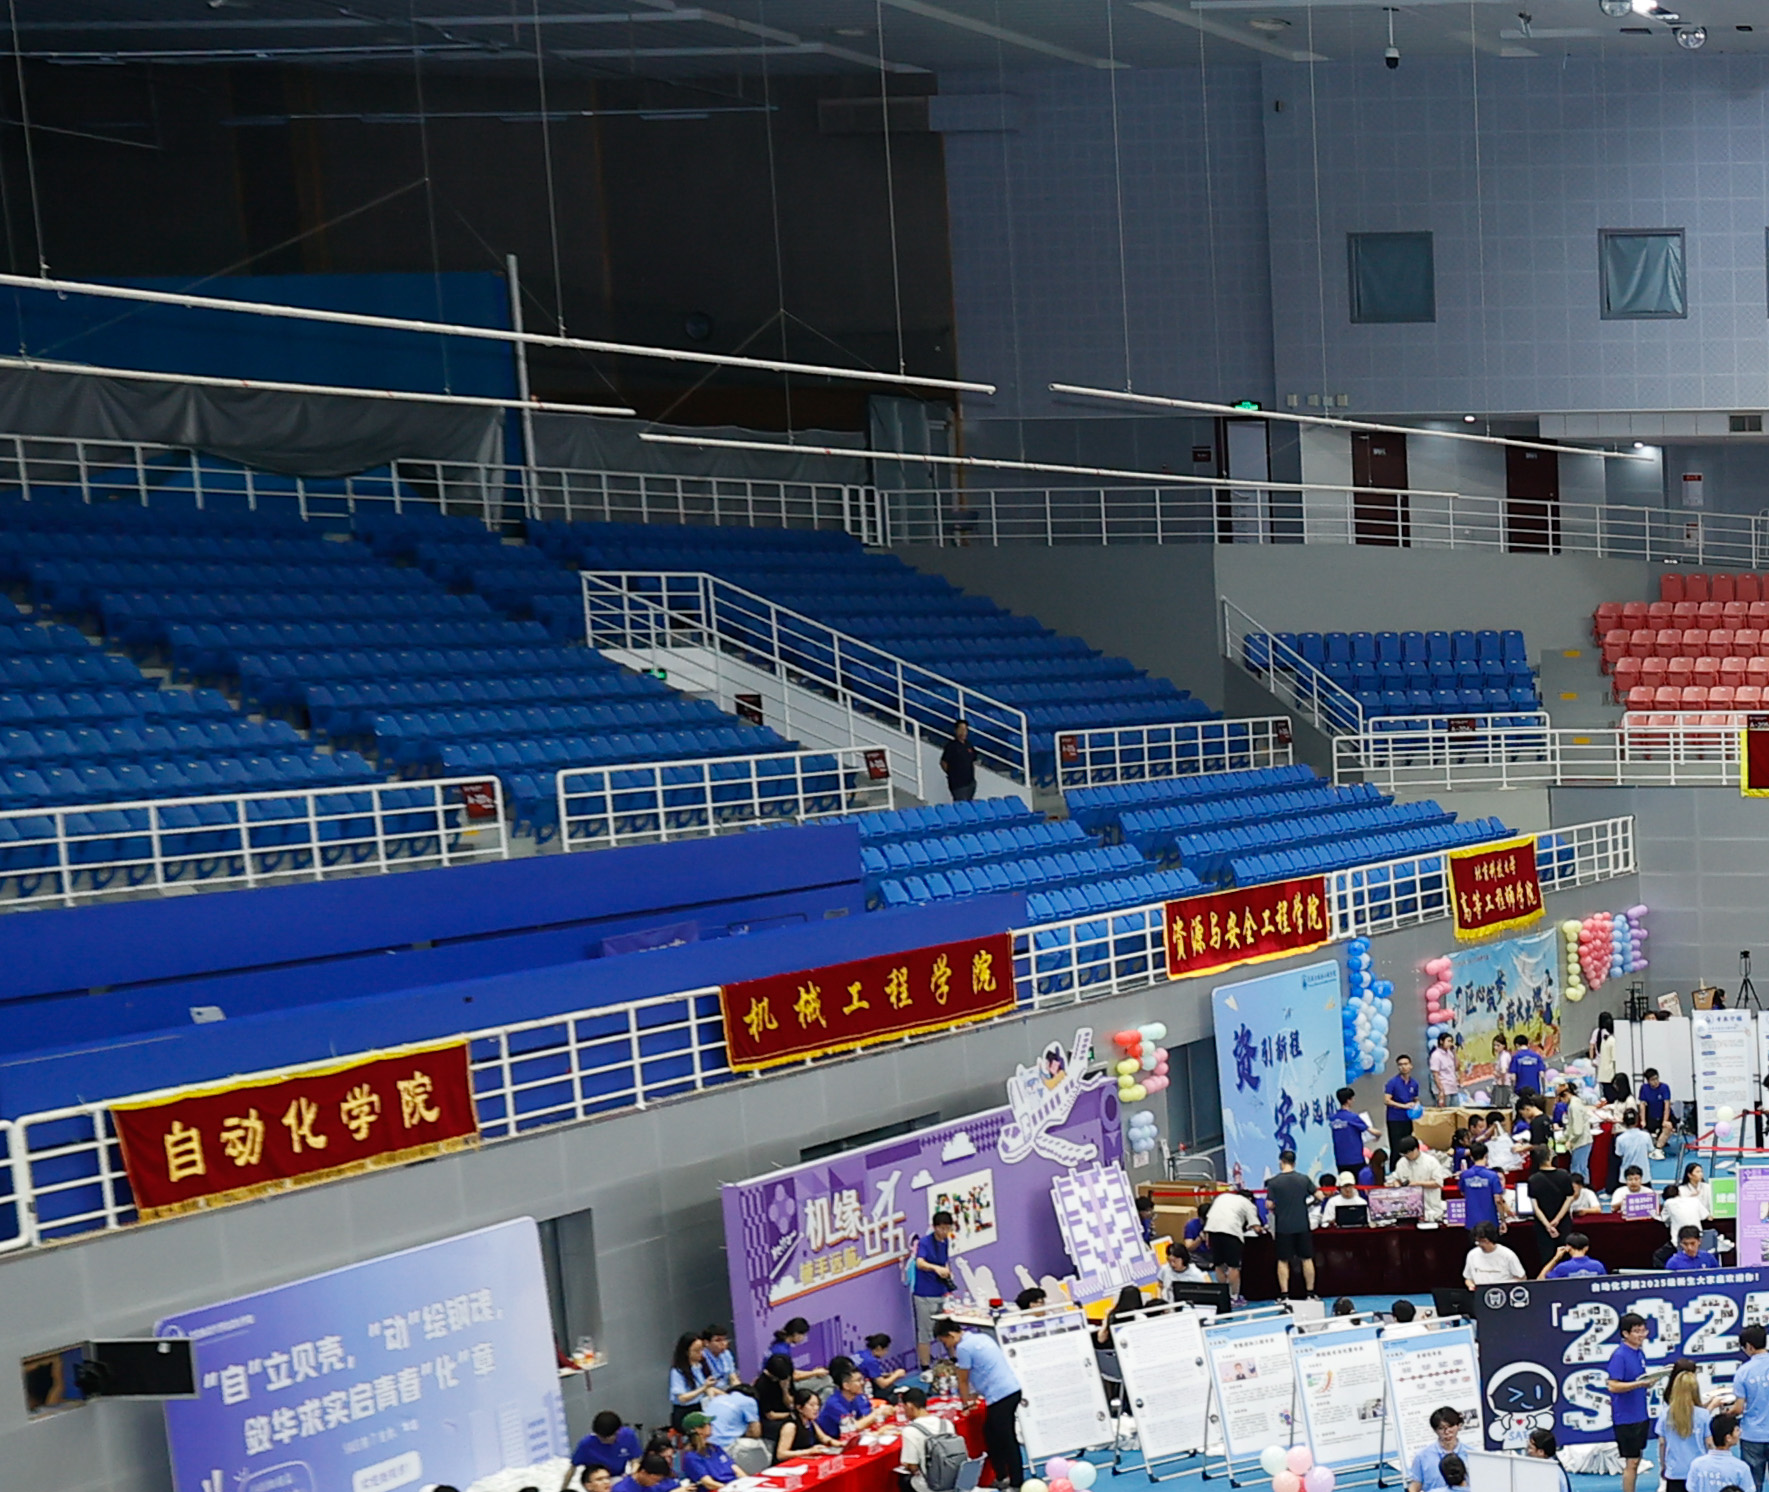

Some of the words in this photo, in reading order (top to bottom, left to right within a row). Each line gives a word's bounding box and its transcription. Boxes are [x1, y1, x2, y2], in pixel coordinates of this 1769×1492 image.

[1171, 890, 1324, 962] 资源与安全工程学院
[743, 948, 999, 1045] 机械工程学院
[162, 1070, 442, 1184] 自动化学院
